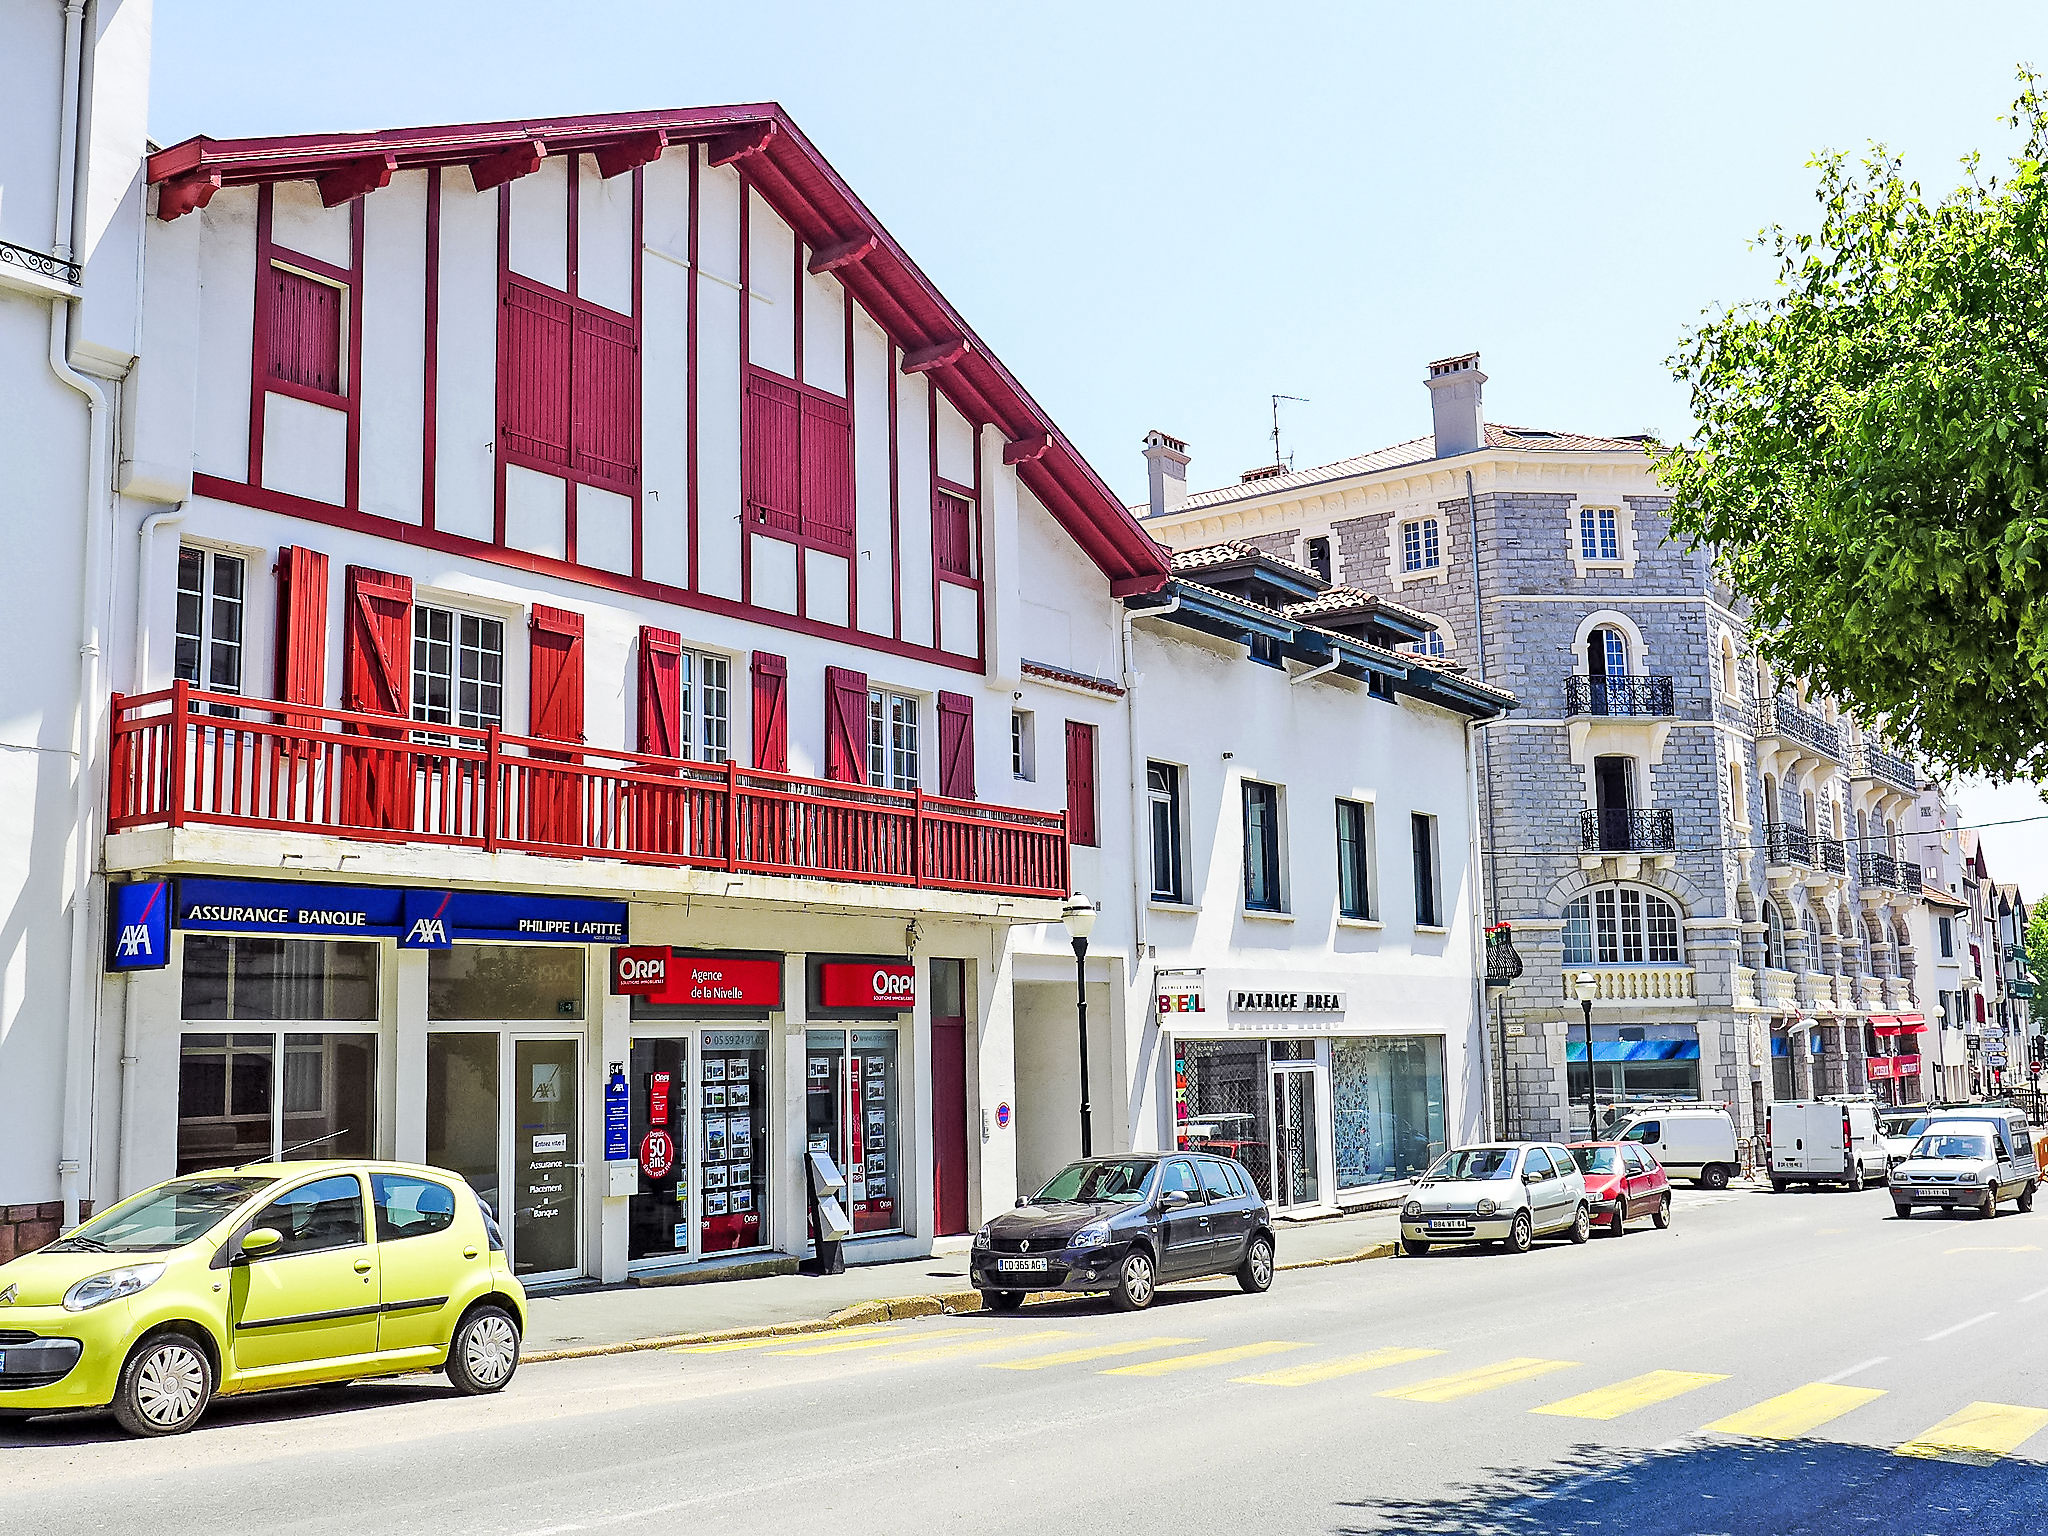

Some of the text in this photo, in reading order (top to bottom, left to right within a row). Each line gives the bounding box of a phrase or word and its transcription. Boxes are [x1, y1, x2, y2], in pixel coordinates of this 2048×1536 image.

[188, 905, 366, 926] ASSURANCE BANQUE
[404, 918, 447, 944] AXA
[519, 919, 622, 936] PHILIPPE LAFITTE
[115, 924, 153, 957] AXA
[690, 968, 723, 983] Agence
[690, 987, 743, 999] de la Nivelle
[1237, 992, 1298, 1008] PATRICE
[1158, 993, 1206, 1013] BREAL
[532, 1082, 557, 1099] AXA
[649, 1138, 666, 1158] 50
[529, 1160, 563, 1170] Assurance
[649, 1156, 665, 1168] ans
[529, 1184, 563, 1194] Placement
[533, 1208, 559, 1219] Banque
